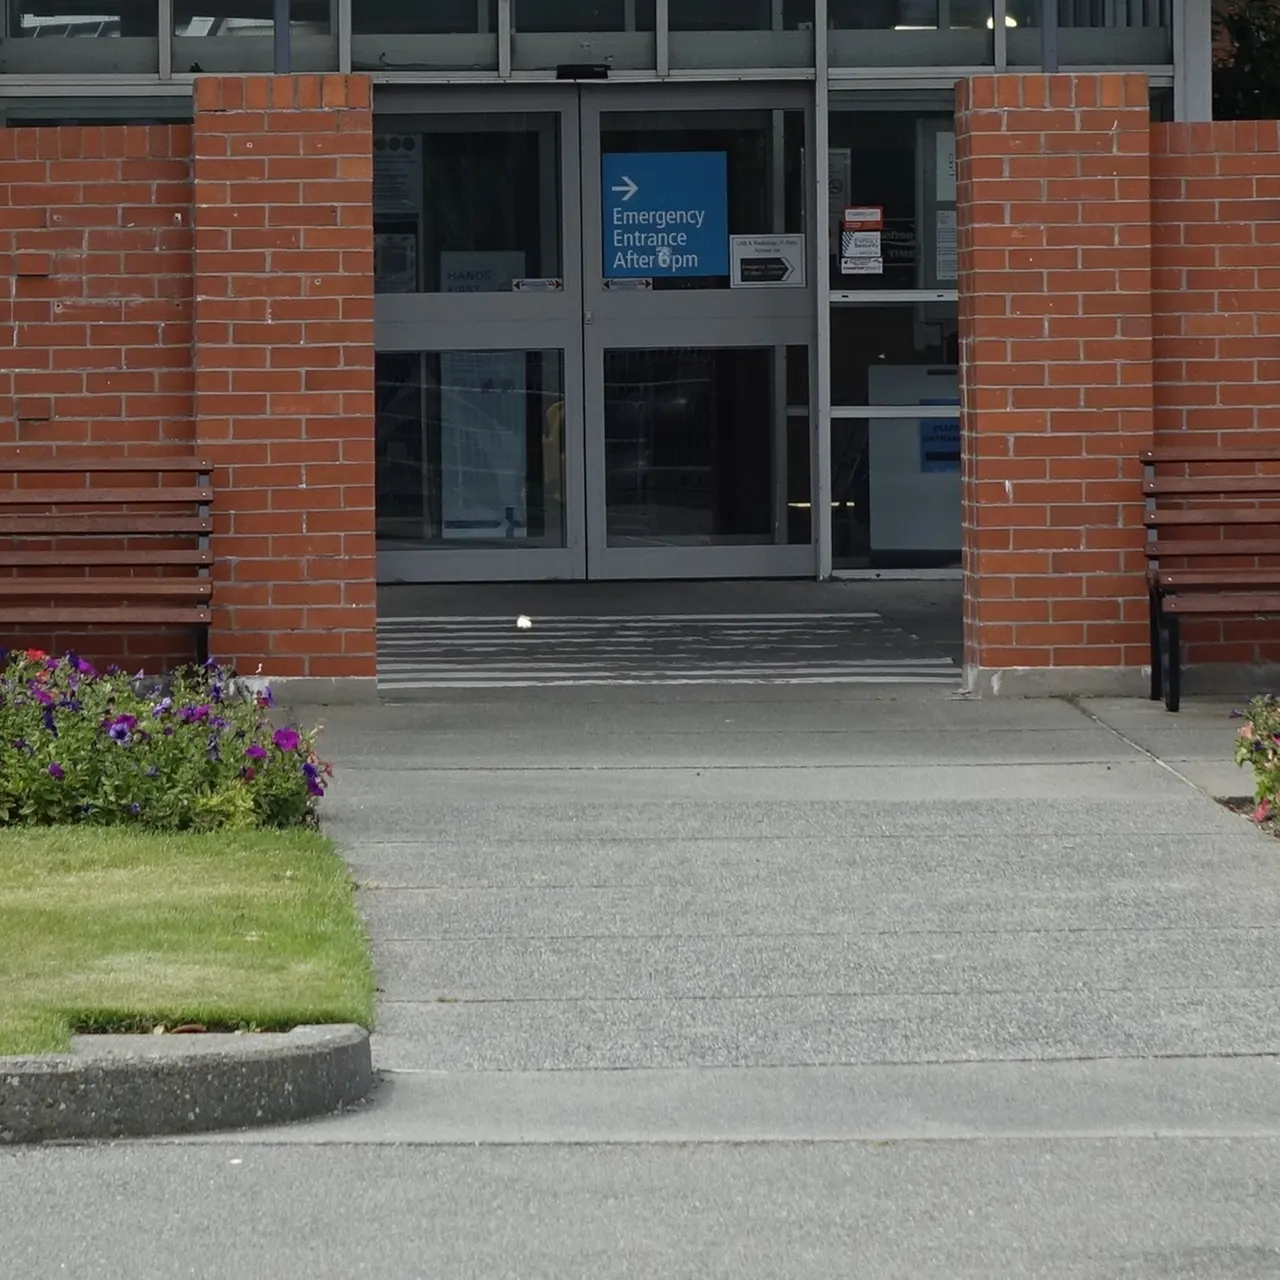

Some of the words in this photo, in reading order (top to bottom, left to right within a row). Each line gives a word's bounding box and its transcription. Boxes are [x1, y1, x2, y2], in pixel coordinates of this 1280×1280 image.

[613, 207, 705, 228] Emergency
[613, 229, 687, 246] Entrance
[613, 250, 655, 268] After
